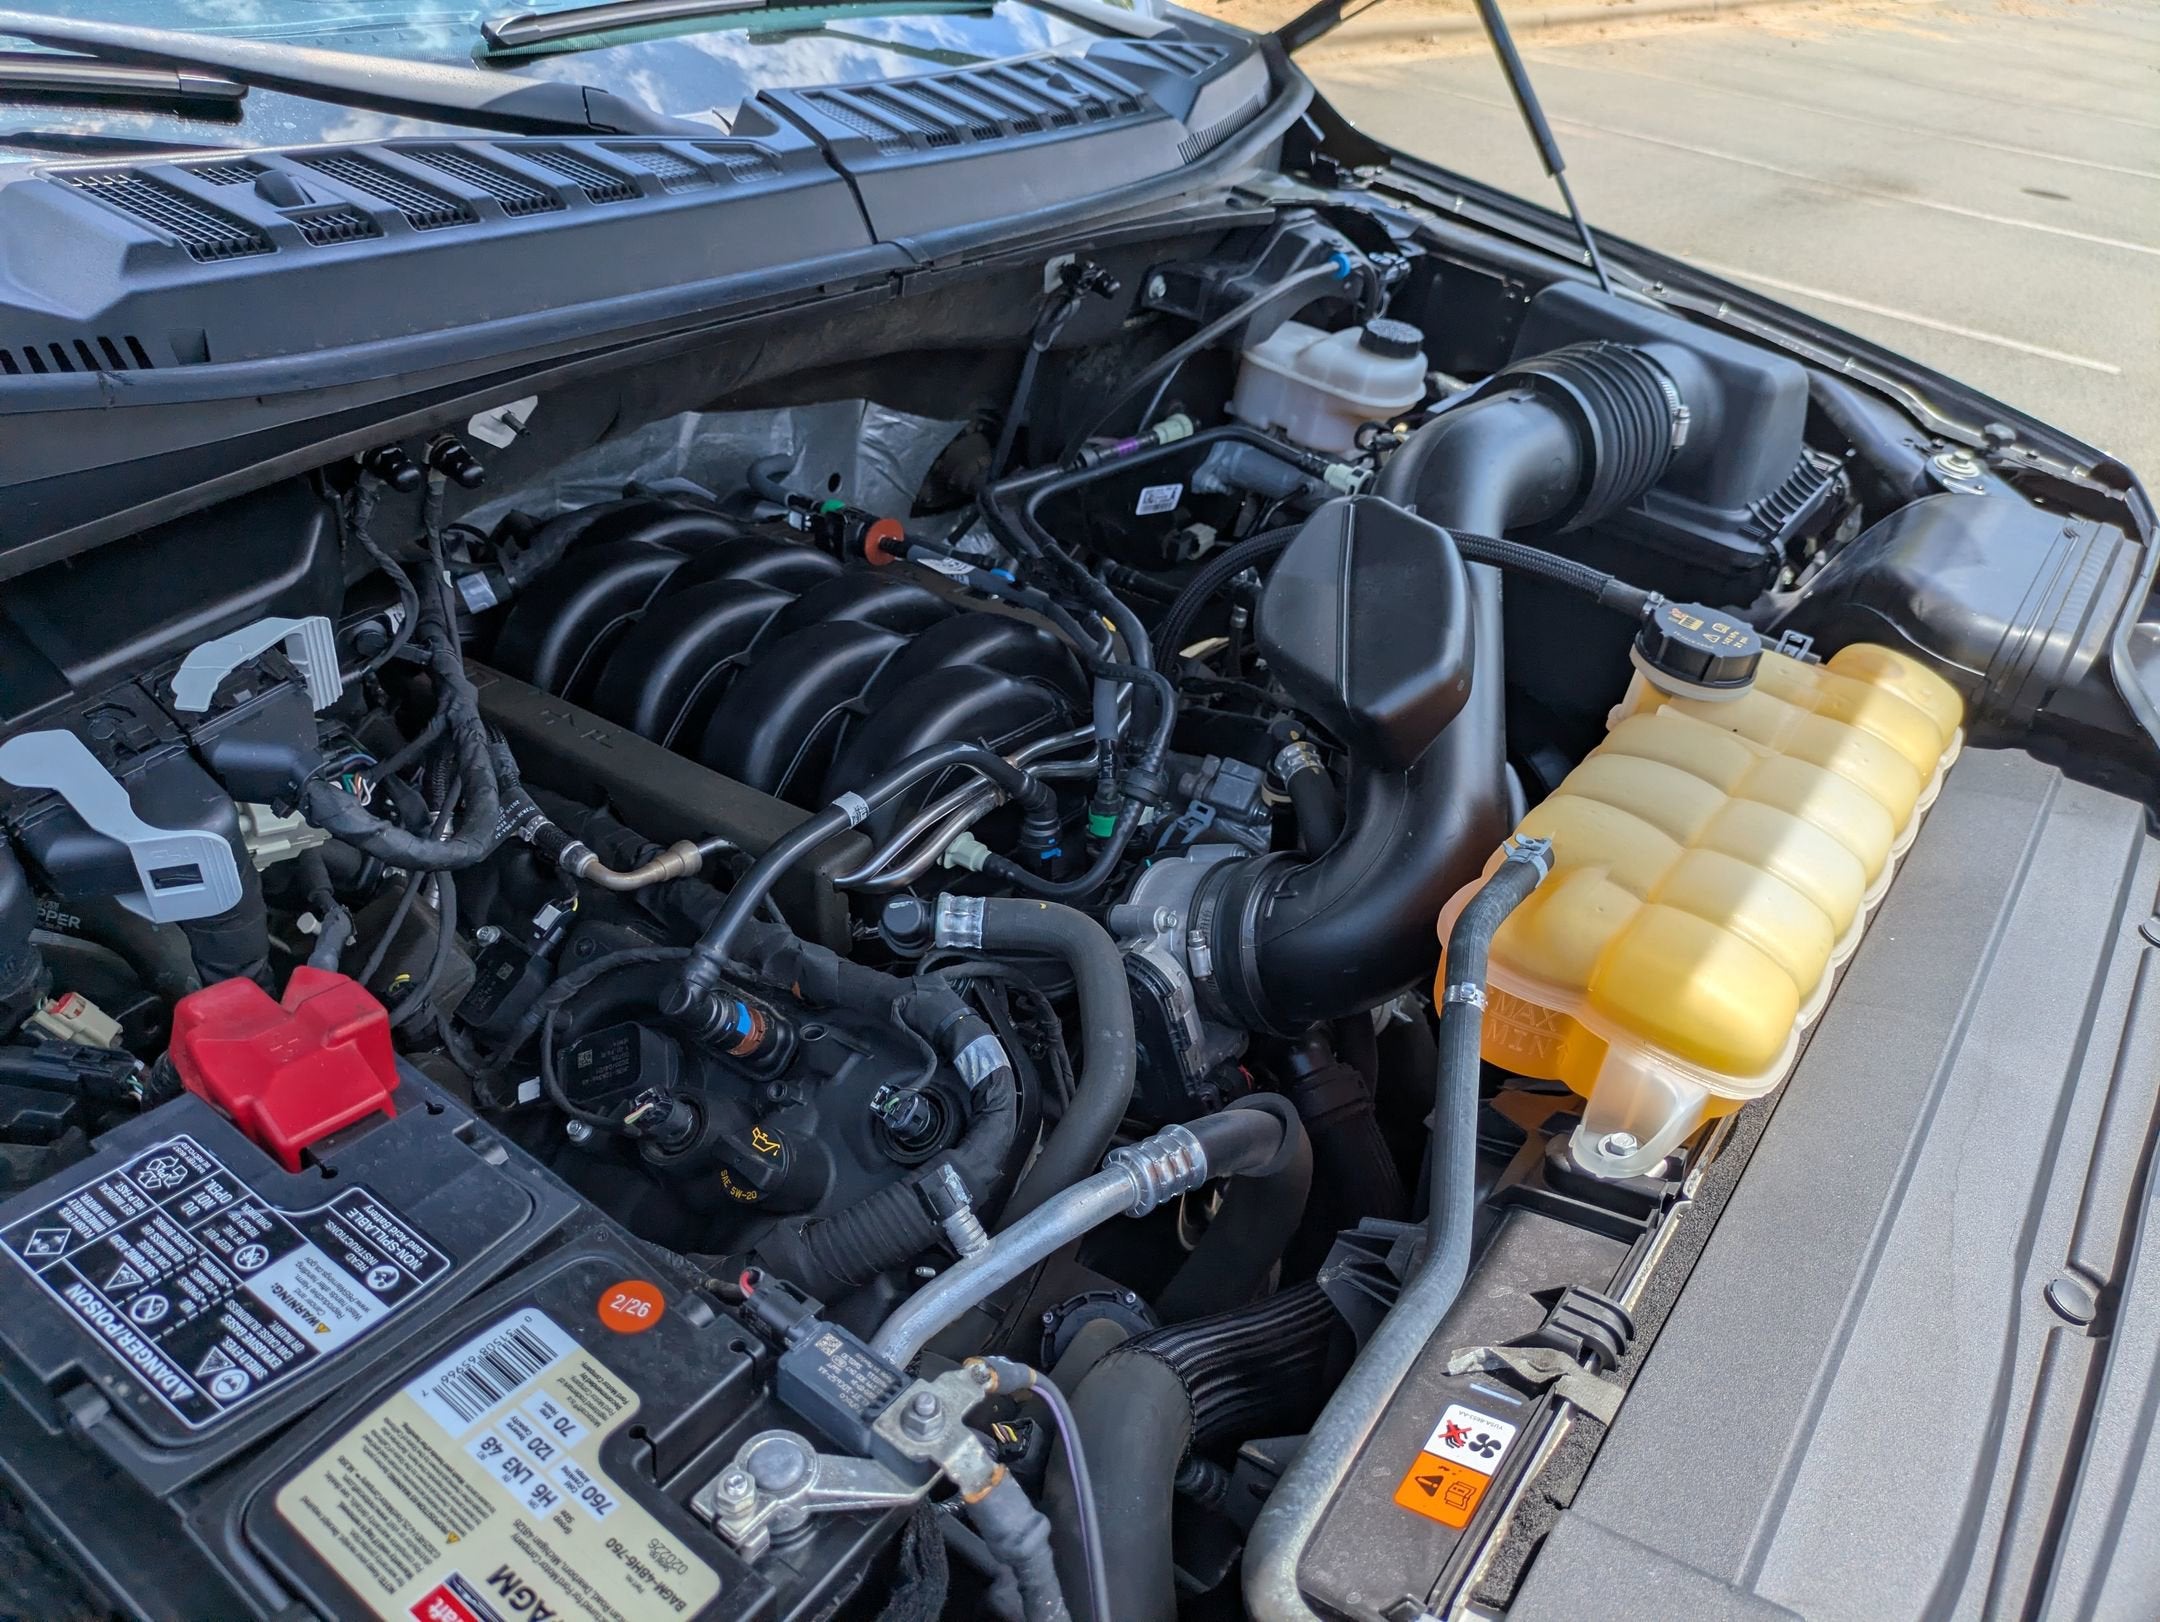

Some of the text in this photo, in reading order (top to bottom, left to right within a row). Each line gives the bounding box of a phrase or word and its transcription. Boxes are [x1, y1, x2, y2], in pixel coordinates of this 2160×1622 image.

[1495, 994, 1559, 1032] MAX
[1486, 1019, 1552, 1058] MIN
[181, 1142, 206, 1163] RECYCLED
[155, 1167, 169, 1178] Pb
[721, 1169, 757, 1200] SAE 5W-20
[96, 1181, 136, 1215] GET MEDICAL
[113, 1180, 147, 1209] HELP FAST.
[191, 1189, 217, 1209] NOT
[201, 1178, 234, 1203] OPEN.
[65, 1197, 107, 1232] IMMEDIATELY
[77, 1191, 118, 1226] WITH WATER.
[180, 1200, 201, 1216] DO
[238, 1201, 273, 1229] CHILDREN.
[57, 1206, 96, 1239] FLUSH EYES
[150, 1214, 197, 1255] SEVERE BURNS.
[221, 1224, 247, 1245] OF THE
[226, 1210, 260, 1237] REACH OF
[362, 1203, 429, 1258] Lead Acid Battery
[140, 1223, 185, 1262] BLINDNESS OR
[202, 1226, 235, 1253] KEEP OUT
[322, 1218, 379, 1265] INSTRUCTIONS.
[345, 1207, 423, 1269] NON-SPILLABLE
[107, 1232, 159, 1278] SULFURIC ACID
[135, 1238, 172, 1270] CAN CAUSE
[343, 1251, 369, 1272] READ
[188, 1268, 218, 1292] FLAMES
[197, 1256, 230, 1285] SMOKING
[175, 1275, 206, 1300] SPARKS
[315, 1279, 332, 1293] after
[327, 1290, 348, 1307] hands
[176, 1297, 197, 1313] NO
[267, 1281, 321, 1327] WARNING:
[292, 1287, 326, 1316] Cancer and
[307, 1286, 346, 1319] Reproductive
[343, 1304, 363, 1320] Wash
[610, 1294, 651, 1318] 2/26
[62, 1282, 182, 1391] DANGER/POISON
[218, 1313, 283, 1368] EXPLOSIVE GASES
[223, 1298, 295, 1360] CAN CAUSE BLINDNESS
[266, 1319, 306, 1353] OR INJURY.
[476, 1327, 516, 1357] 31508
[217, 1335, 268, 1379] SHIELD EYES.
[437, 1353, 479, 1385] 65966
[578, 1371, 622, 1410] Recommended by
[588, 1392, 605, 1407] Motor
[600, 1379, 619, 1395] Motor
[614, 1392, 629, 1405] Ford
[541, 1400, 559, 1416] Hours
[601, 1404, 615, 1416] Ford
[504, 1421, 527, 1441] Reserve
[508, 1414, 534, 1436] Capacity
[550, 1415, 578, 1438] 70
[477, 1434, 507, 1459] 48
[524, 1435, 556, 1461] 120
[499, 1455, 535, 1485] LN3
[558, 1464, 587, 1488] Cranking
[573, 1466, 592, 1483] Amps
[528, 1481, 559, 1508] H6
[562, 1479, 579, 1493] Cold
[577, 1483, 616, 1516] 760
[549, 1513, 574, 1535] Group
[557, 1508, 576, 1523] Size
[509, 1531, 543, 1562] Company
[644, 1536, 690, 1576] 020226
[511, 1517, 613, 1611] Road, Dearborn, Michigan 48126
[537, 1559, 561, 1580] Motor
[603, 1535, 688, 1612] BAGM-48H6-760
[555, 1576, 575, 1593] Ford
[570, 1590, 585, 1603] for
